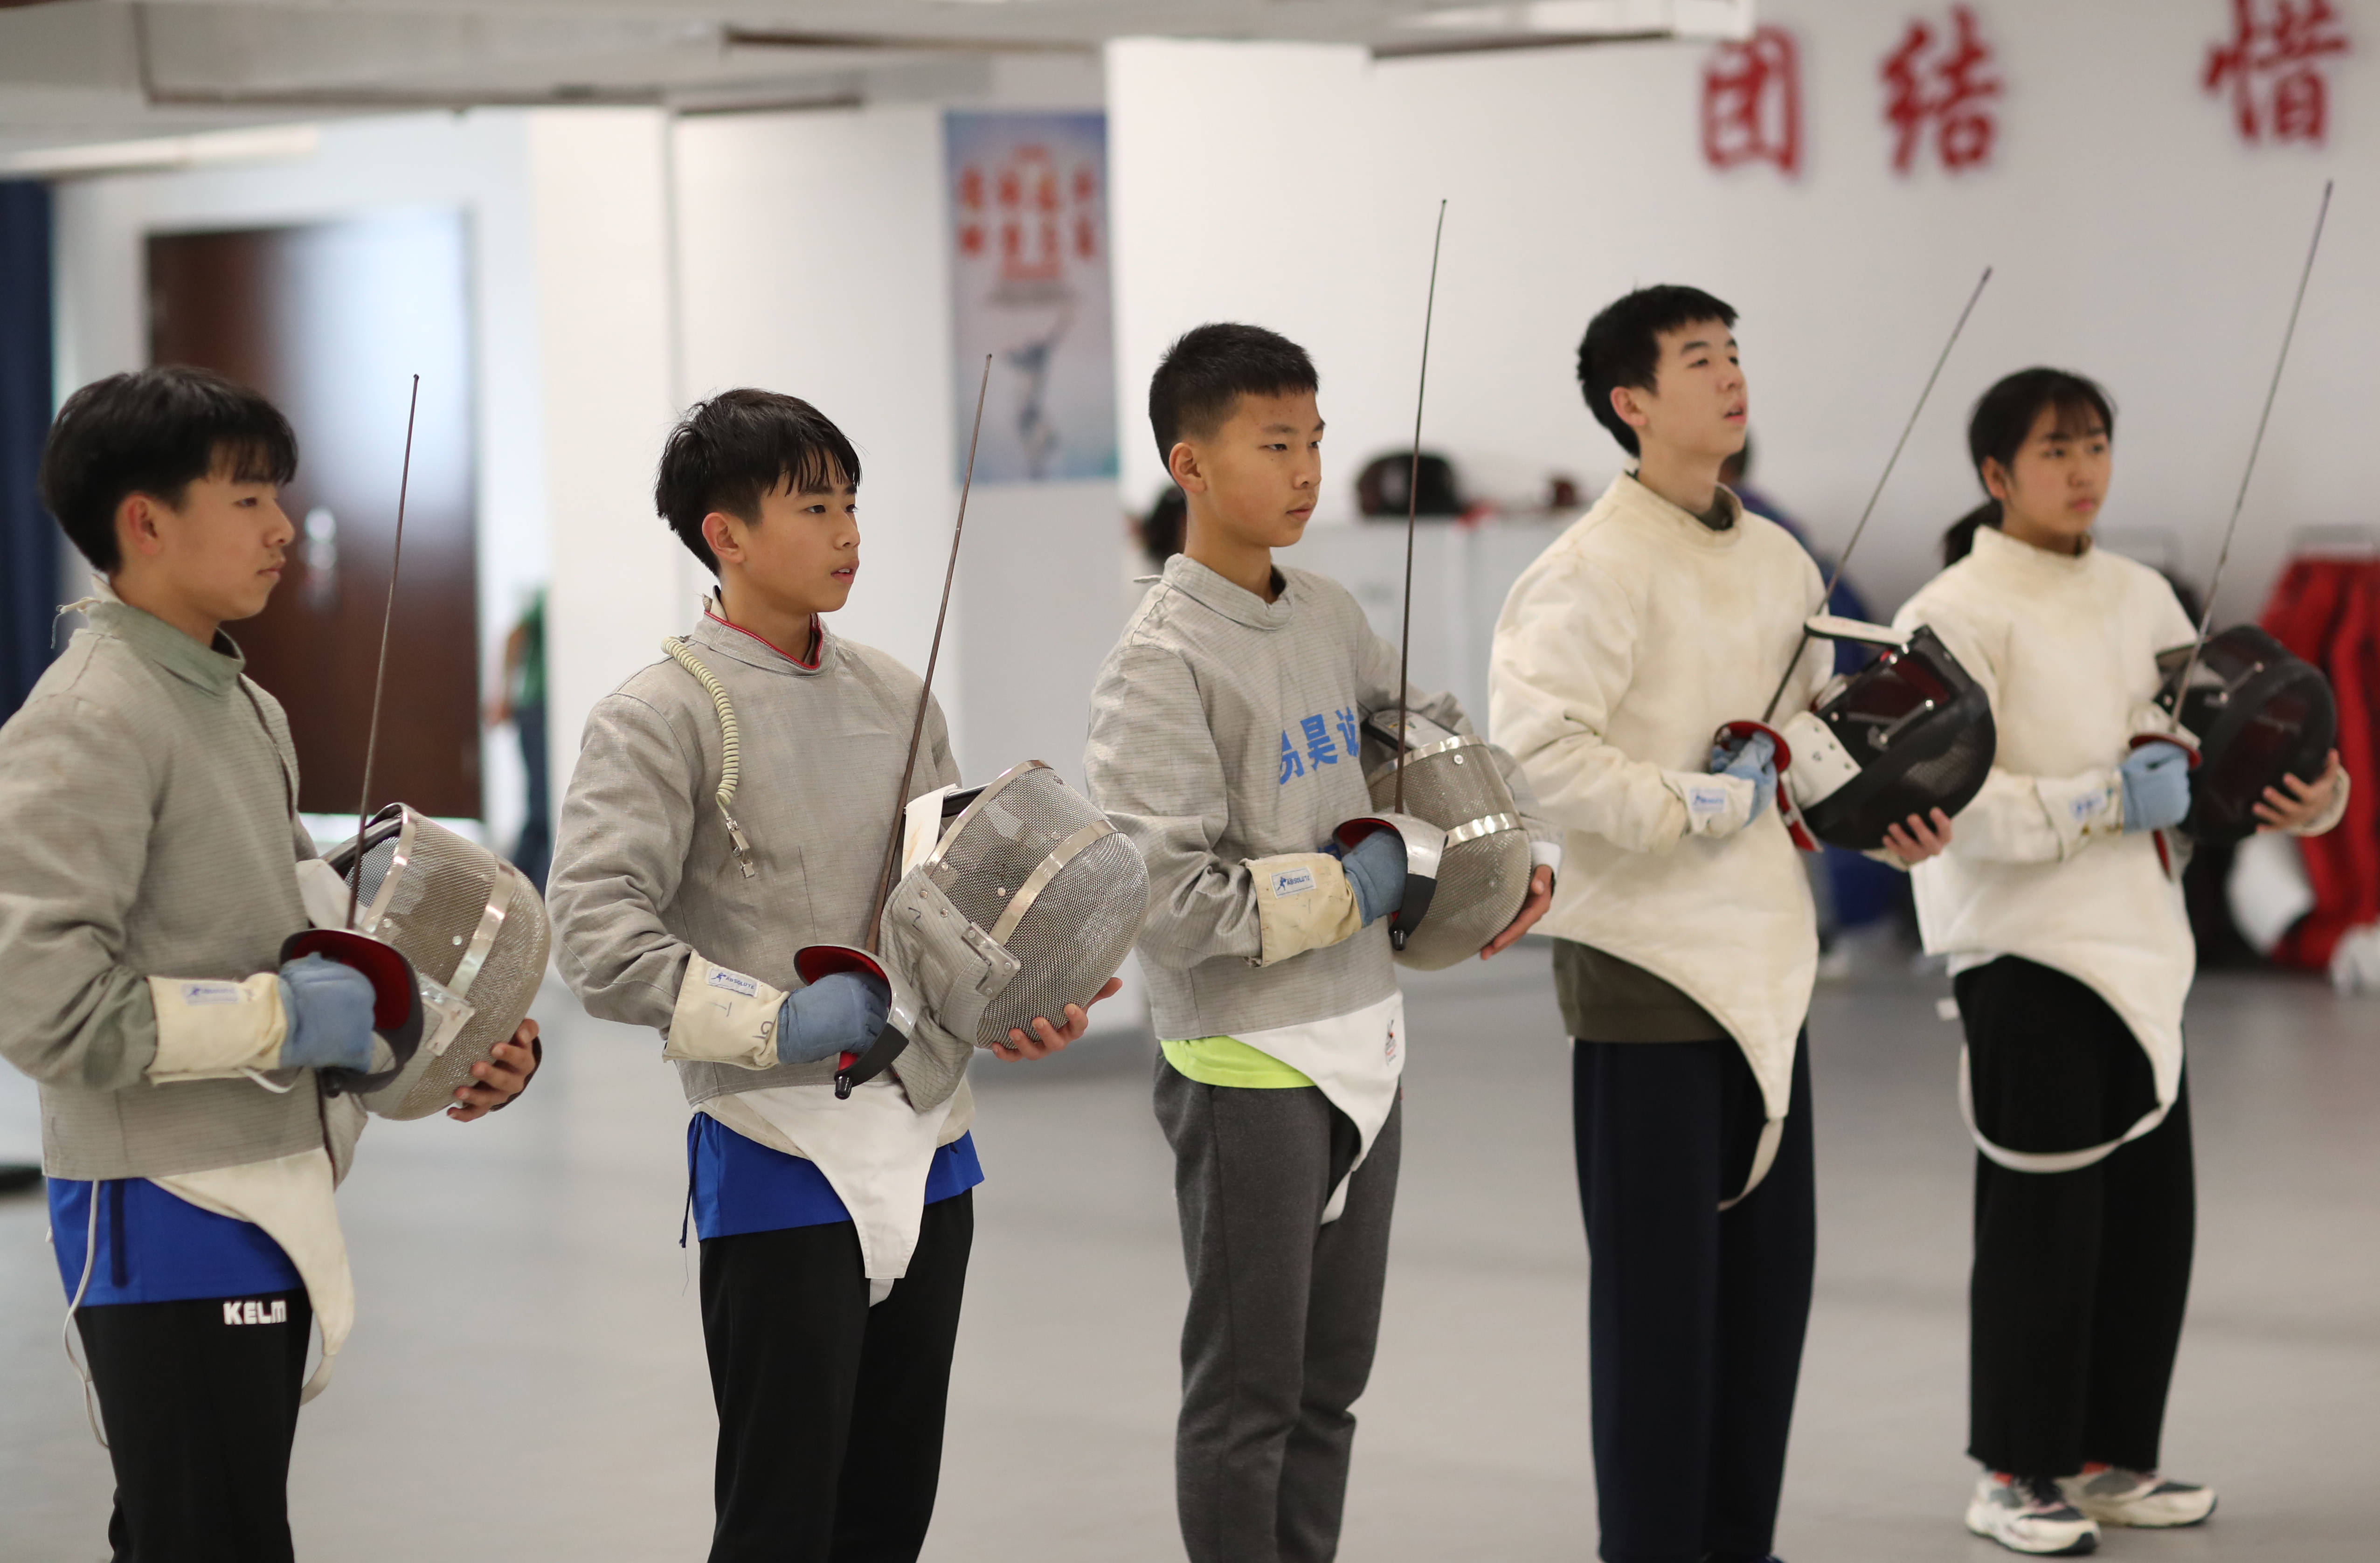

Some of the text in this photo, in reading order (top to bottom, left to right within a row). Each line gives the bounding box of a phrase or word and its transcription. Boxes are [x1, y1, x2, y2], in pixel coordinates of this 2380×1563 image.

[1701, 0, 2349, 174] 团结 惜
[1287, 875, 1310, 885] ABSOLUTE
[726, 976, 755, 989] ABSOLUTE
